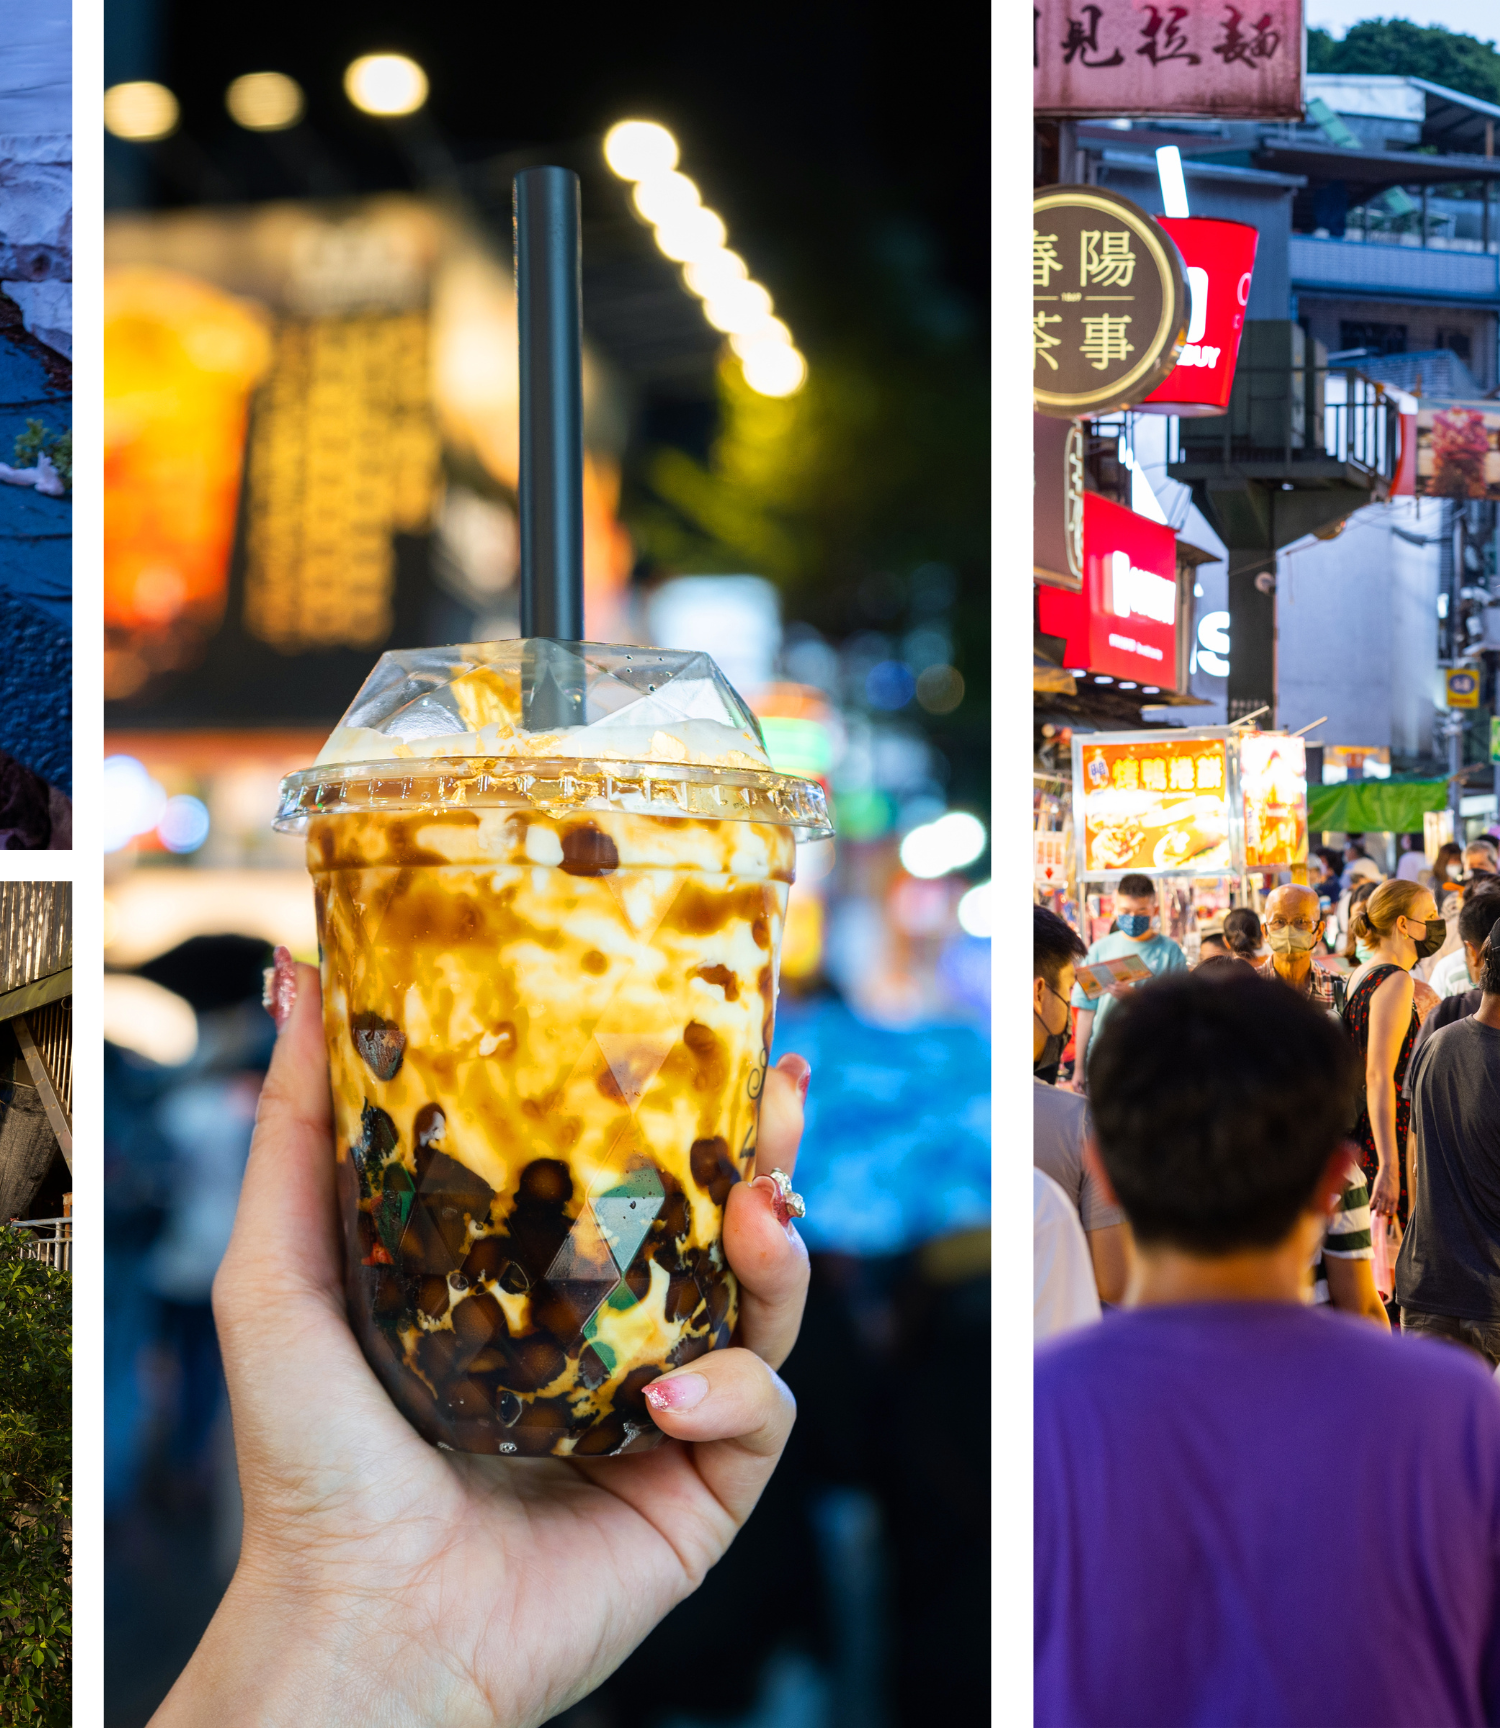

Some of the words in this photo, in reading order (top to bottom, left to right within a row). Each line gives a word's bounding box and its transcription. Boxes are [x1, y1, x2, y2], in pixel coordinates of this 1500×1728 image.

[1034, 4, 1280, 69] 見拉麵
[1033, 229, 1136, 288] 春陽
[1033, 310, 1135, 371] 茶事
